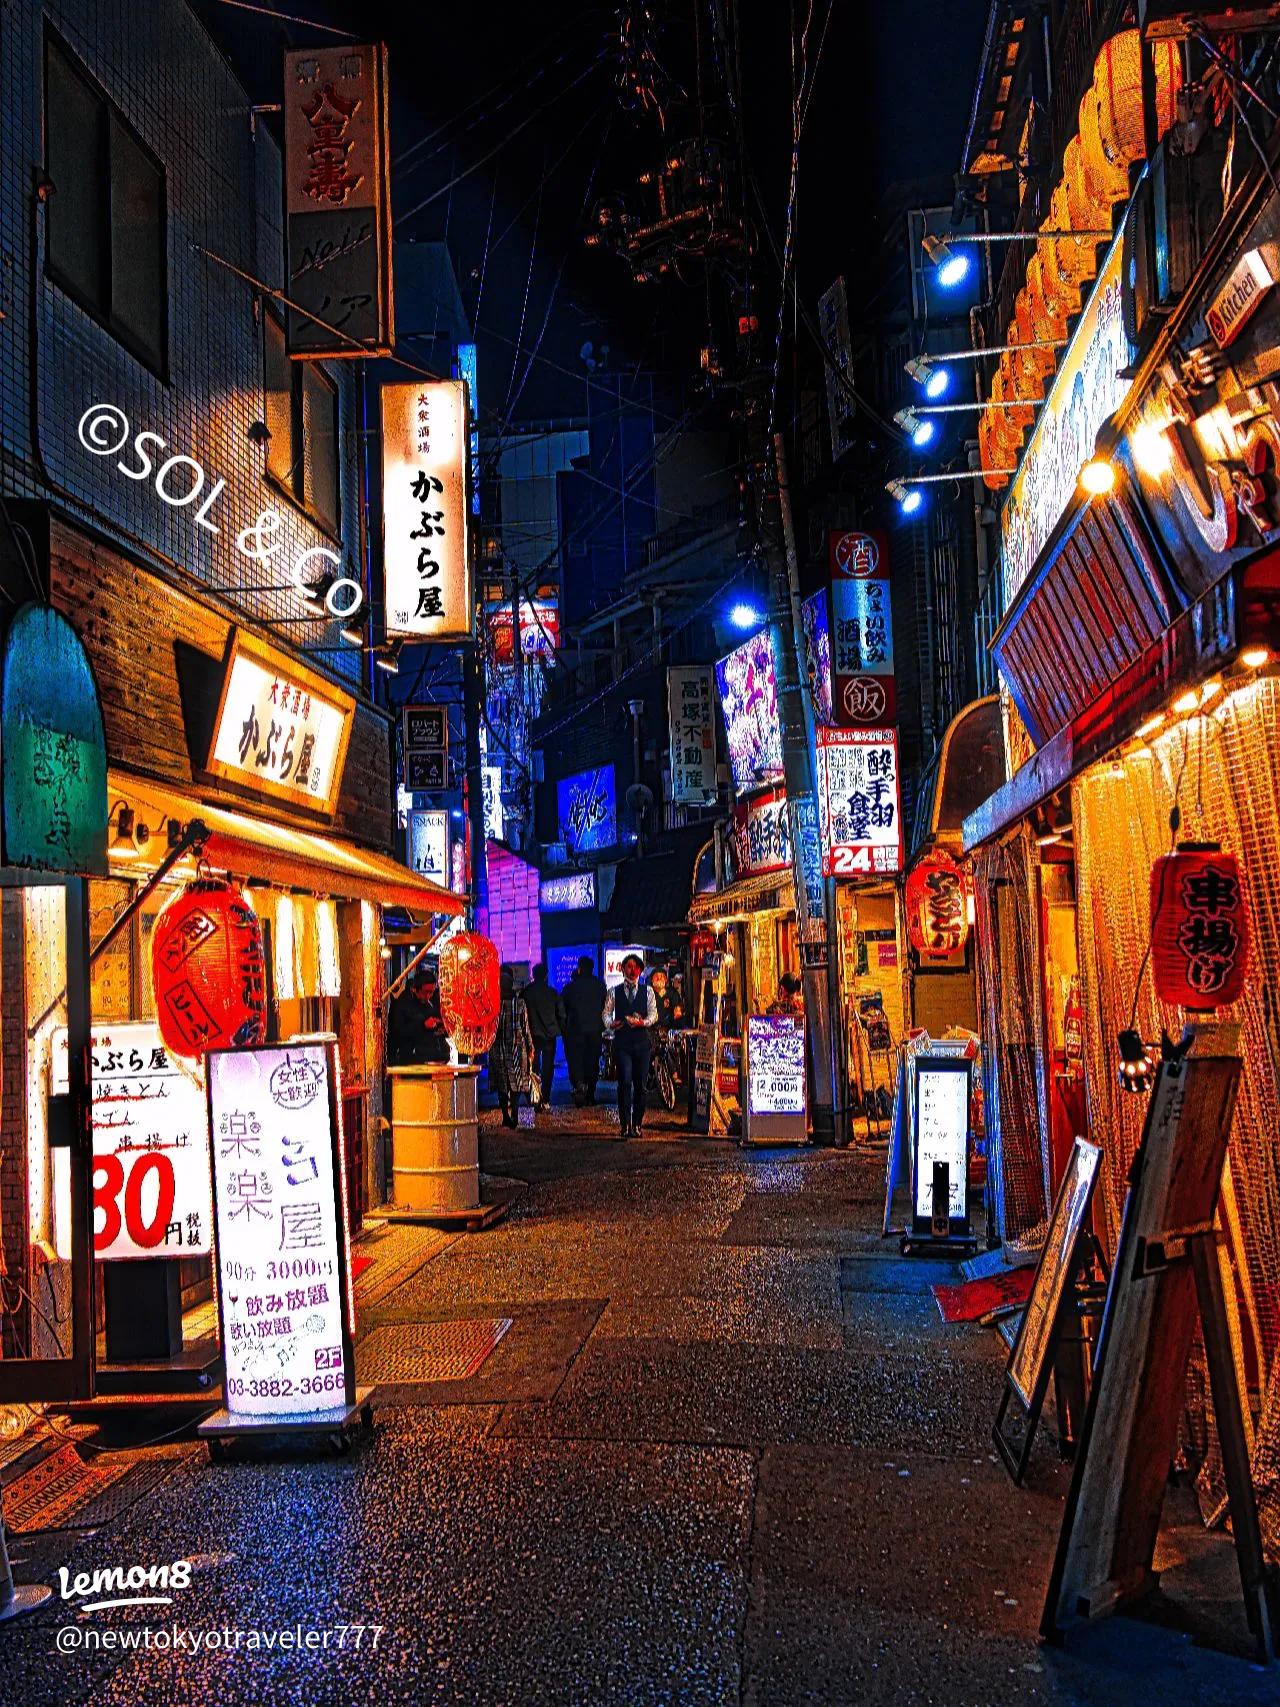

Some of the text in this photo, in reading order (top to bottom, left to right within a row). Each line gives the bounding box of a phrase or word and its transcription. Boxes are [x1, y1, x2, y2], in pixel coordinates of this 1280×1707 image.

[1218, 271, 1258, 328] Kitchen
[417, 393, 430, 454] 大衆酒場
[410, 470, 446, 619] かぶら屋
[837, 618, 862, 671] 酒場
[848, 681, 881, 715] 飯
[238, 703, 315, 785] かぶら屋
[681, 681, 703, 789] 高塚不動産
[866, 748, 896, 828] 酔っ手羽
[413, 816, 444, 829] SNACK
[846, 790, 872, 841] 食堂
[833, 848, 872, 873] 24
[1181, 867, 1240, 993] 串揚げ
[278, 1067, 309, 1085] 女性
[118, 1133, 192, 1152] 串揚げ
[186, 1212, 202, 1246] 税抜
[246, 1283, 330, 1317] 飲み放題
[230, 1316, 292, 1340] 歌い放題
[315, 1346, 342, 1370] 2F
[228, 1372, 345, 1397] 03-3882-3666
